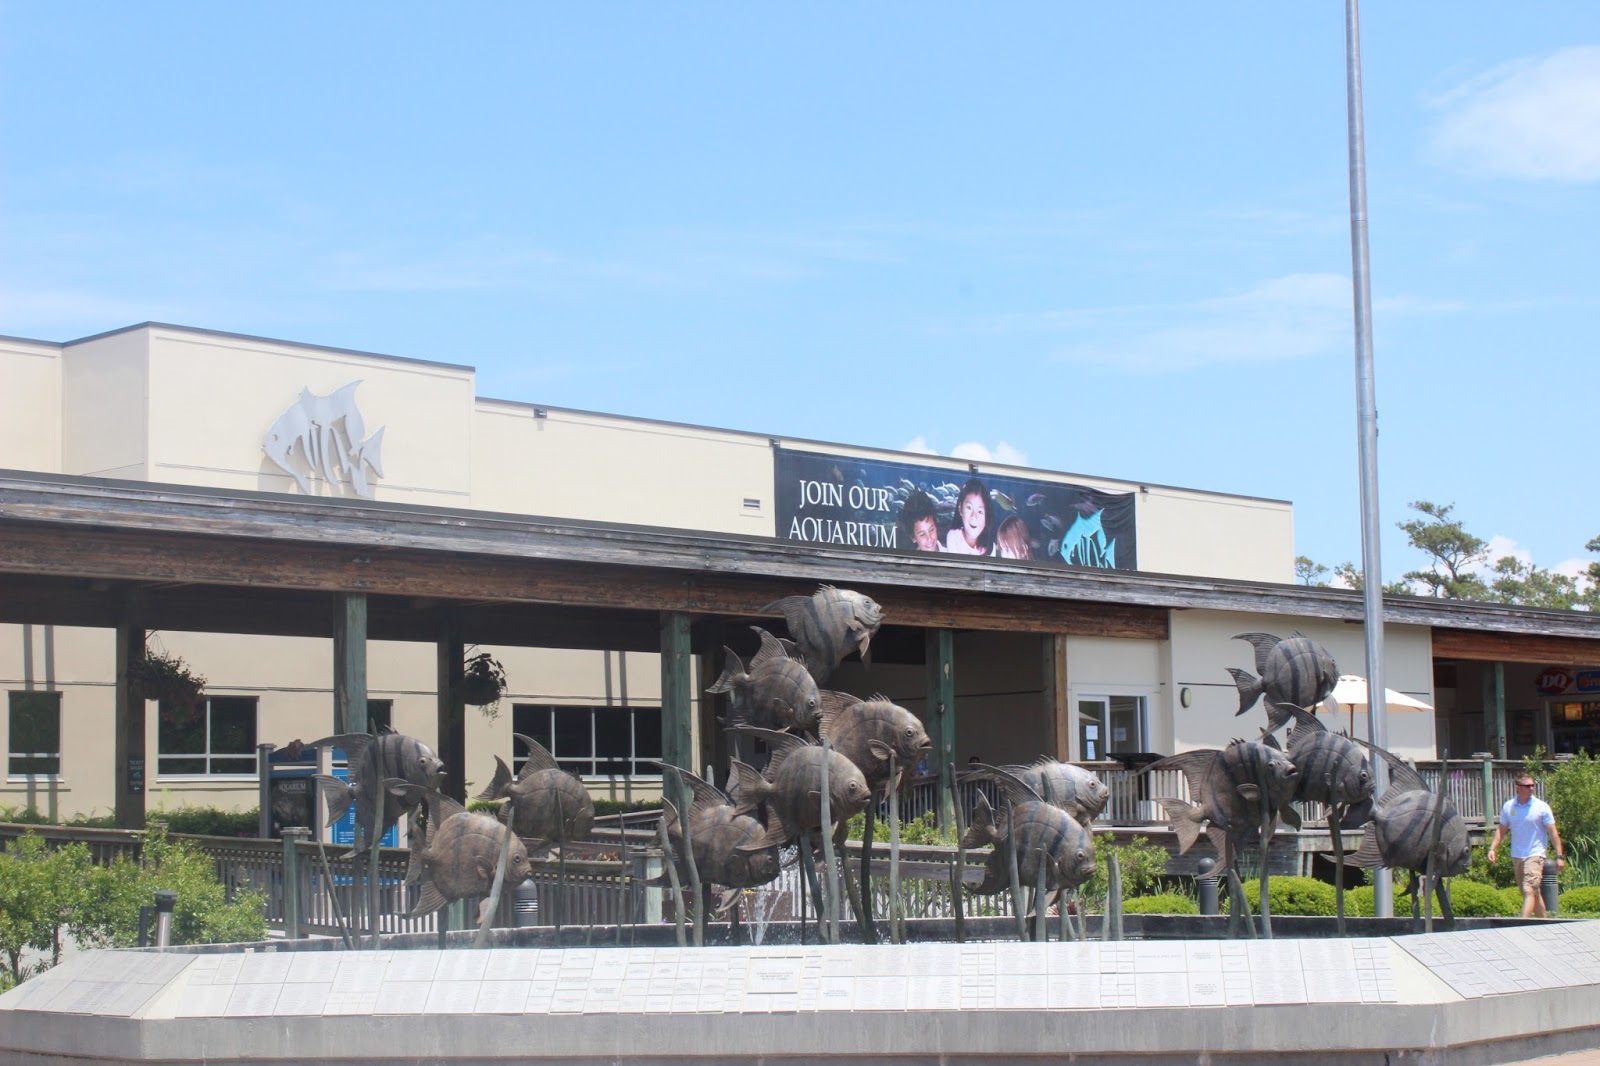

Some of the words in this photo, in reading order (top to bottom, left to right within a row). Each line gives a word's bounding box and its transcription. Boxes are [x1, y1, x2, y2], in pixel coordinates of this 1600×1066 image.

[799, 480, 843, 509] JOIN
[849, 485, 890, 512] OUR
[789, 516, 898, 549] AQUARIUM
[1541, 673, 1567, 689] DQ
[278, 783, 306, 792] AQUARIUM
